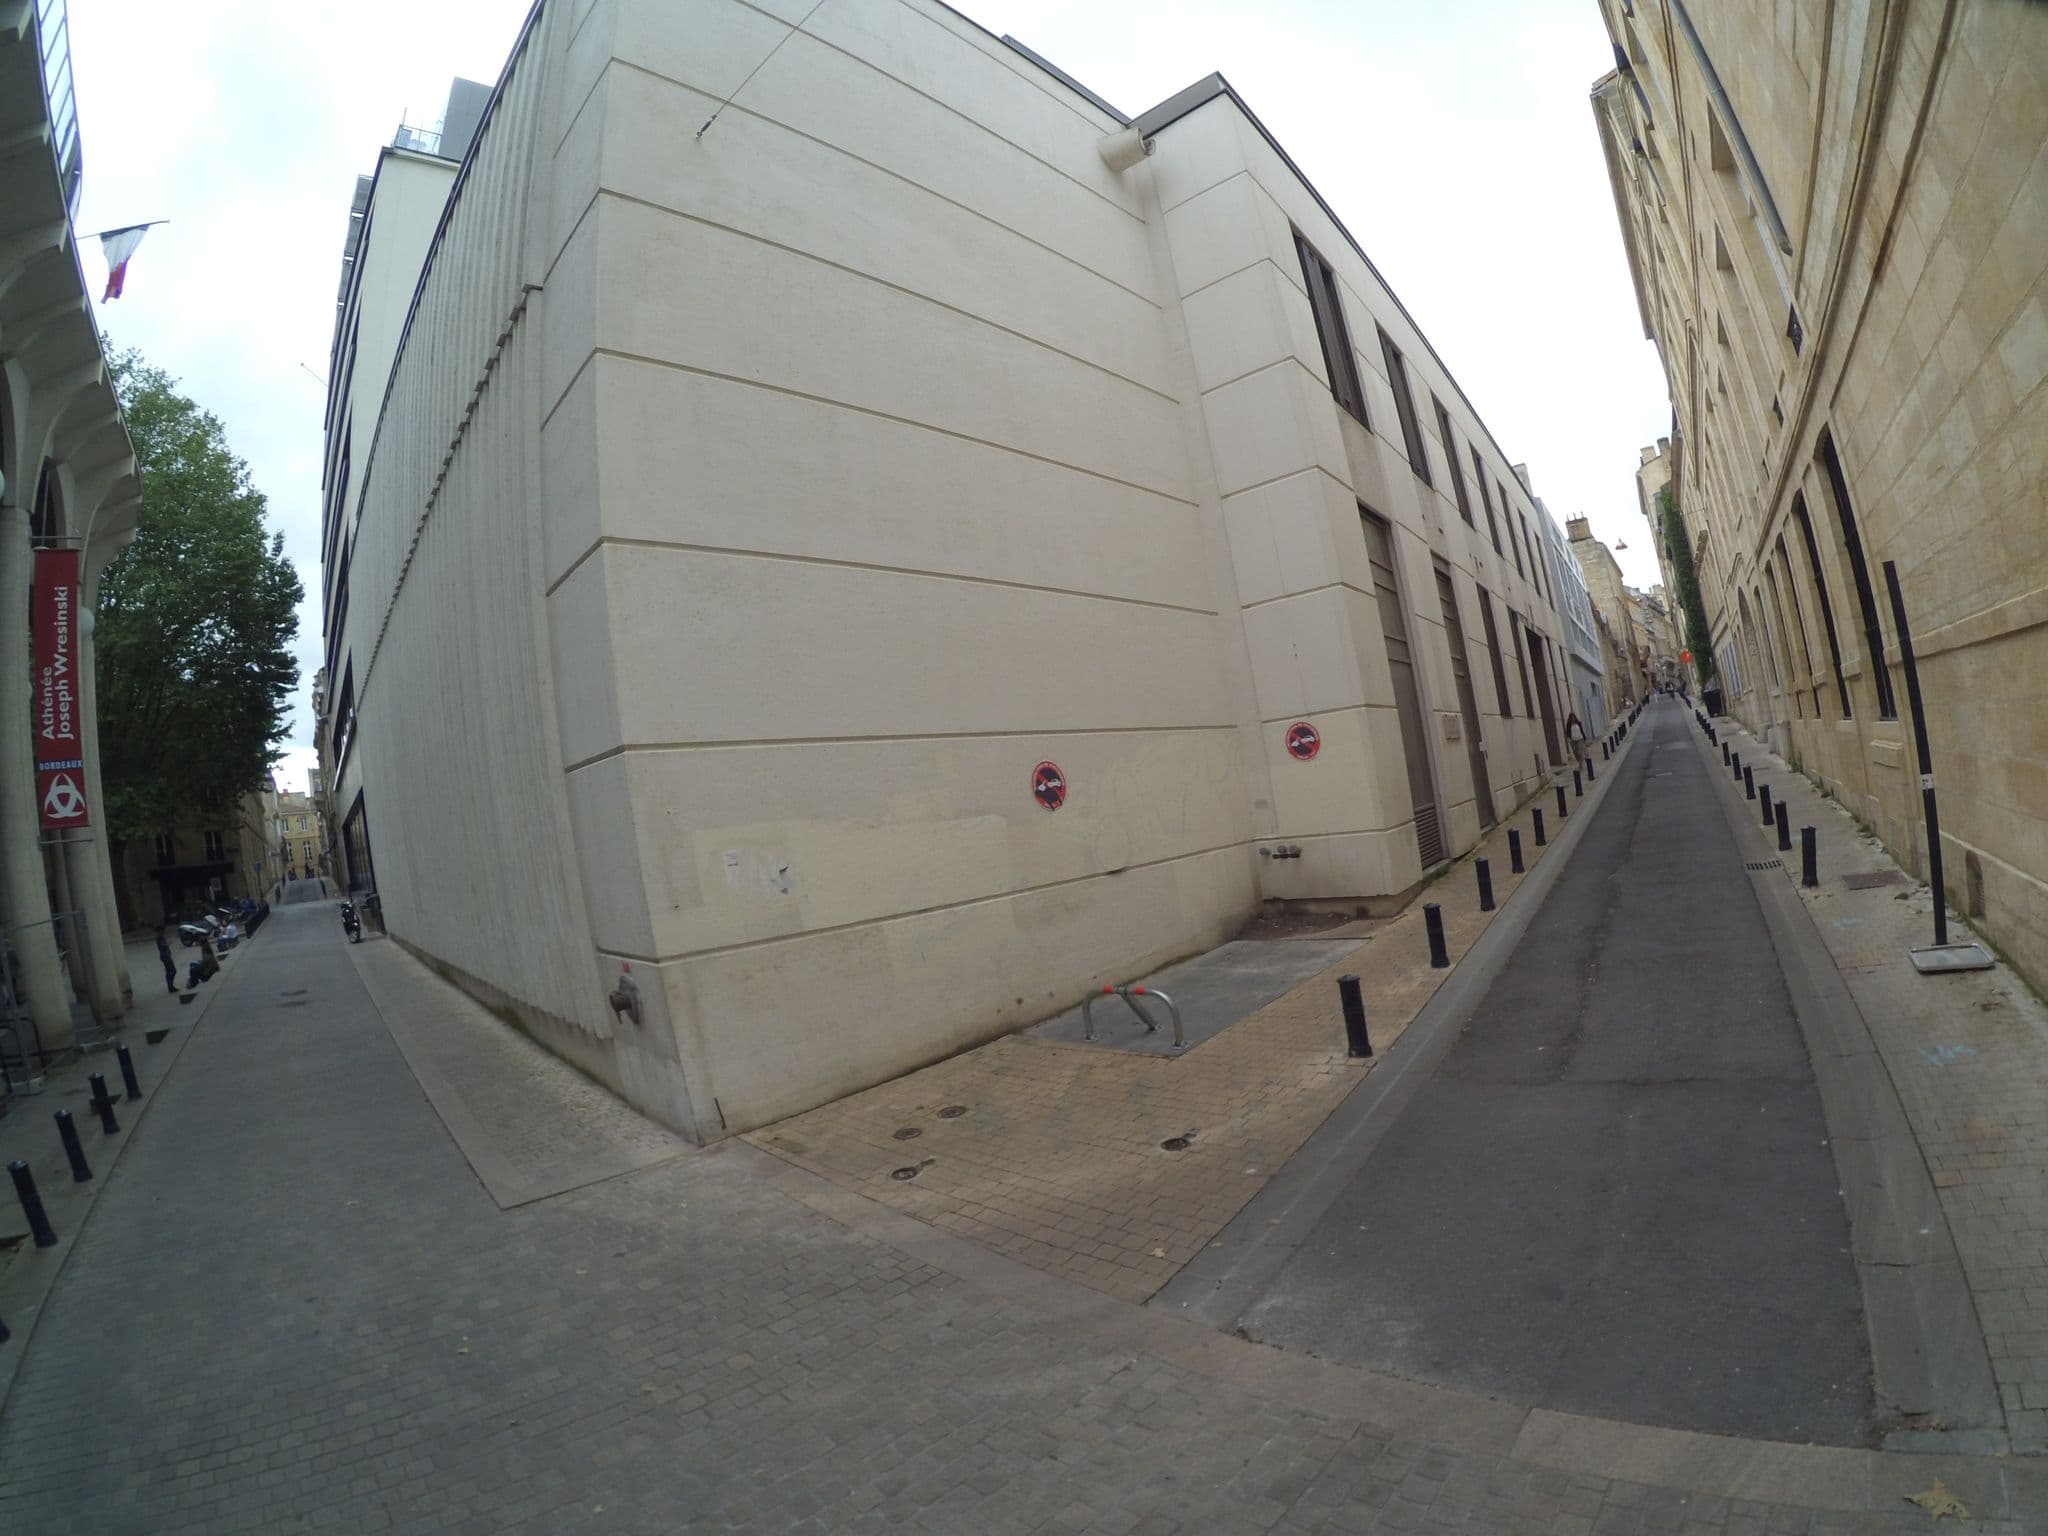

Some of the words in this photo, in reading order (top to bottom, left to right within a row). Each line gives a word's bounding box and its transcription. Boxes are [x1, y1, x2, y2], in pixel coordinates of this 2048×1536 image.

[53, 586, 68, 676] Wresinski
[41, 666, 55, 740] Athénée
[54, 679, 74, 740] Joseph
[39, 760, 83, 771] BORDEAUX
